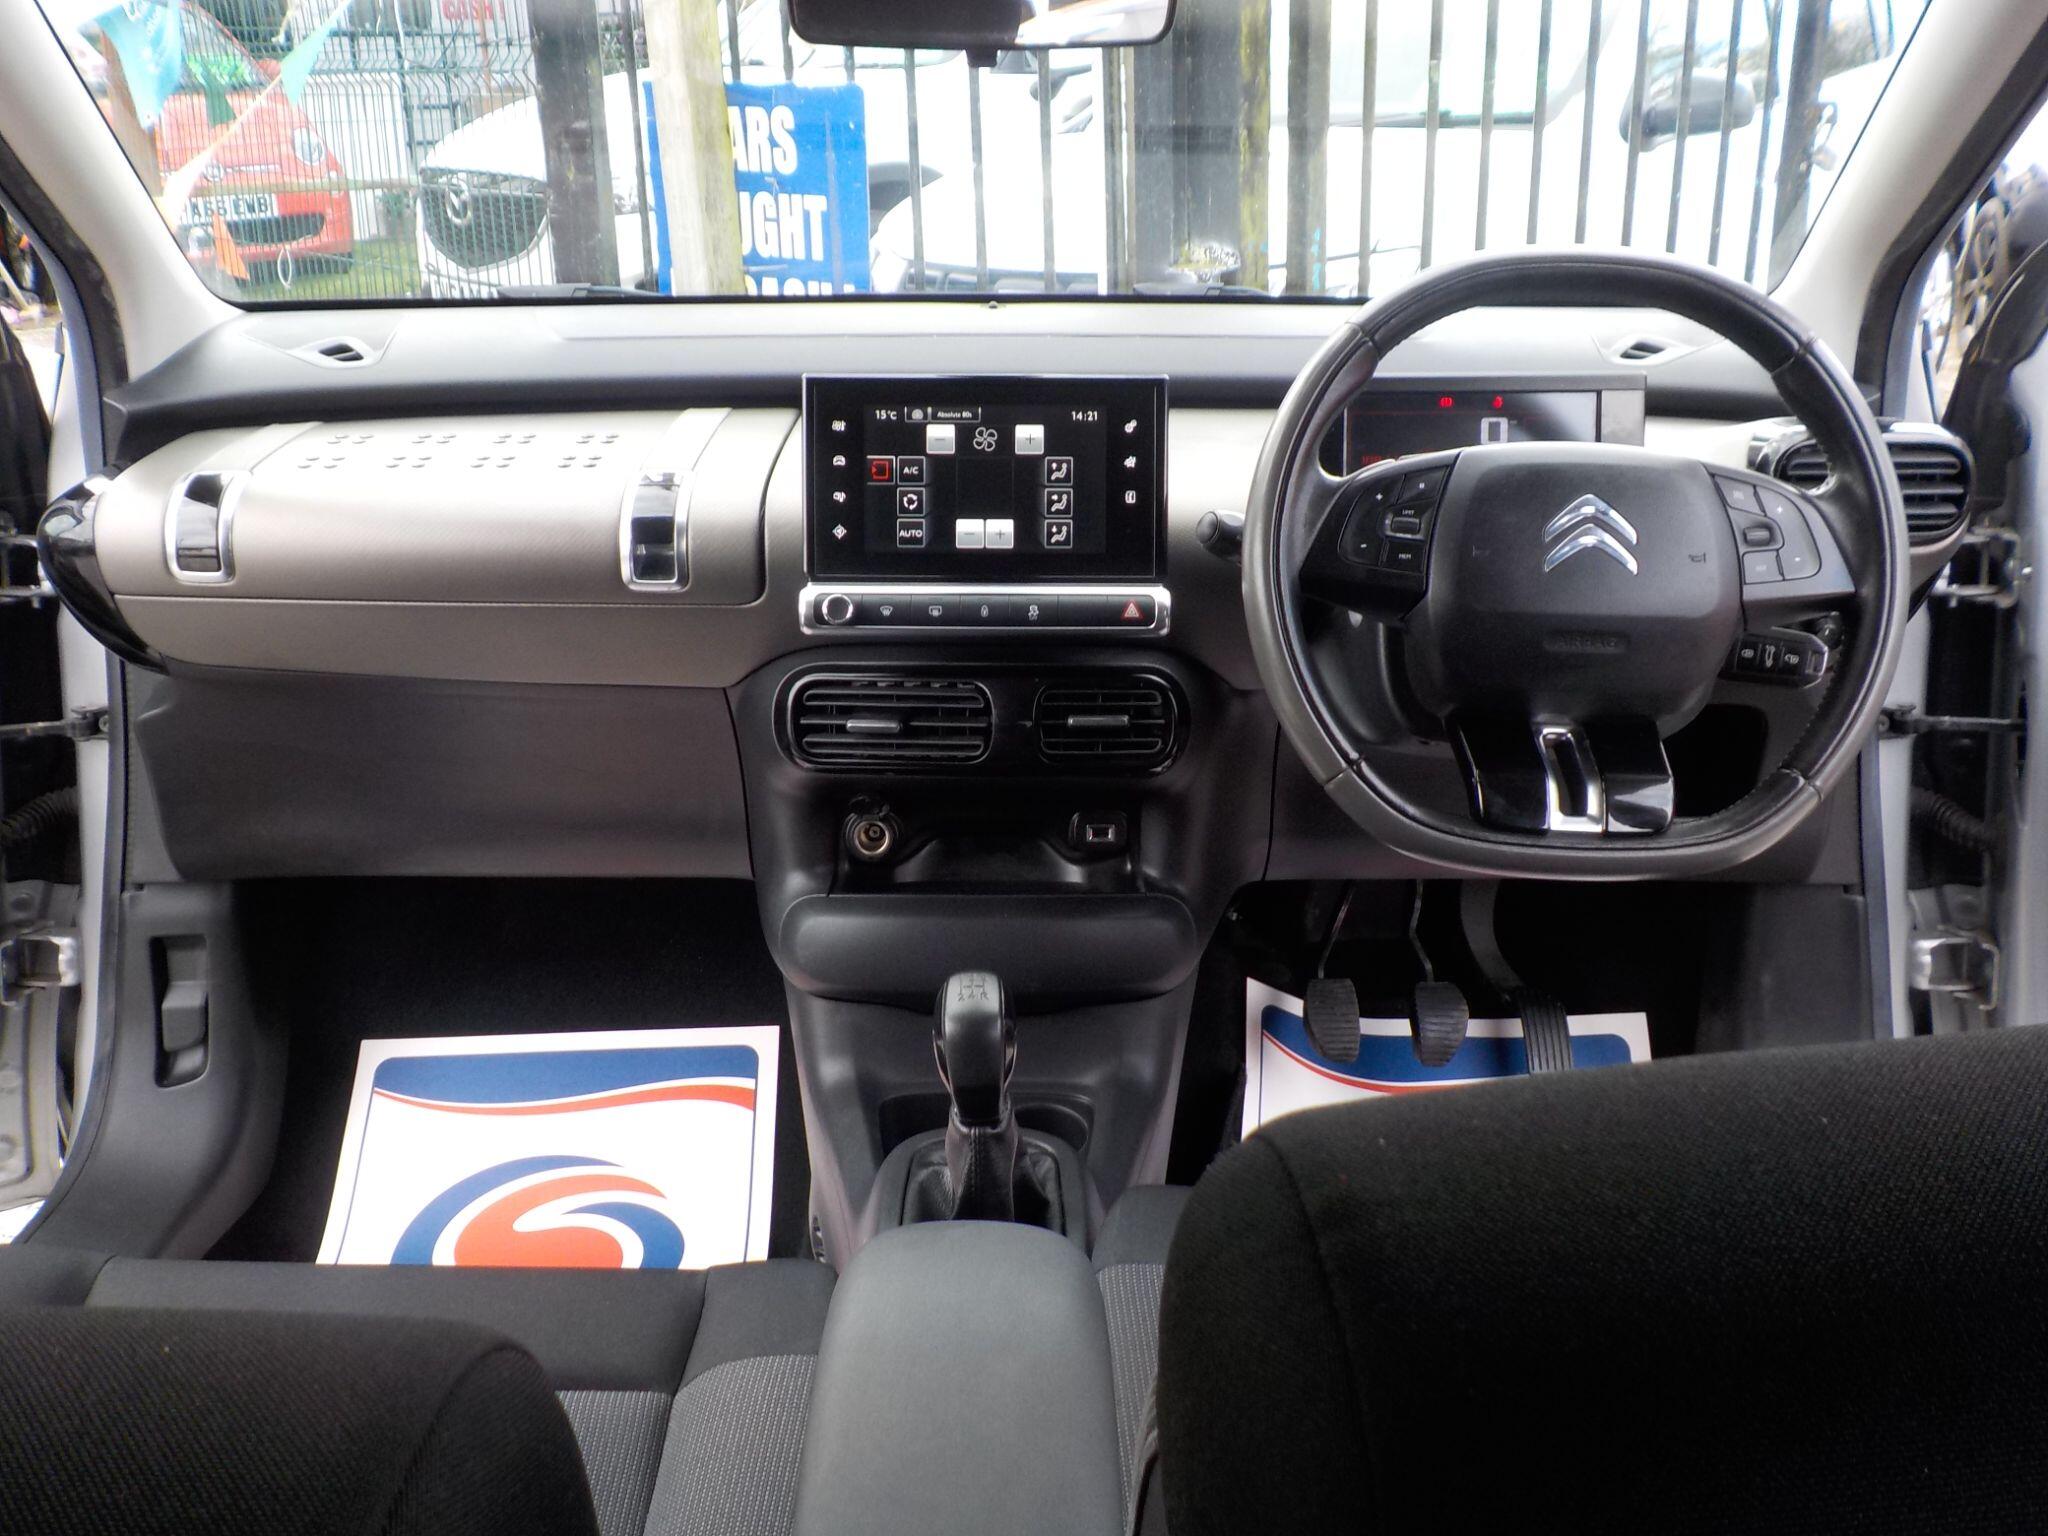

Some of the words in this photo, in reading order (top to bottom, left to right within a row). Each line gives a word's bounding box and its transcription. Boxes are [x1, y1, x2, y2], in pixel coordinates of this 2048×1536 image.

[727, 104, 798, 176] ARS
[875, 410, 898, 420] 15°C
[1071, 410, 1098, 421] 14:21
[903, 466, 919, 475] A/C
[899, 529, 923, 538] AUTO
